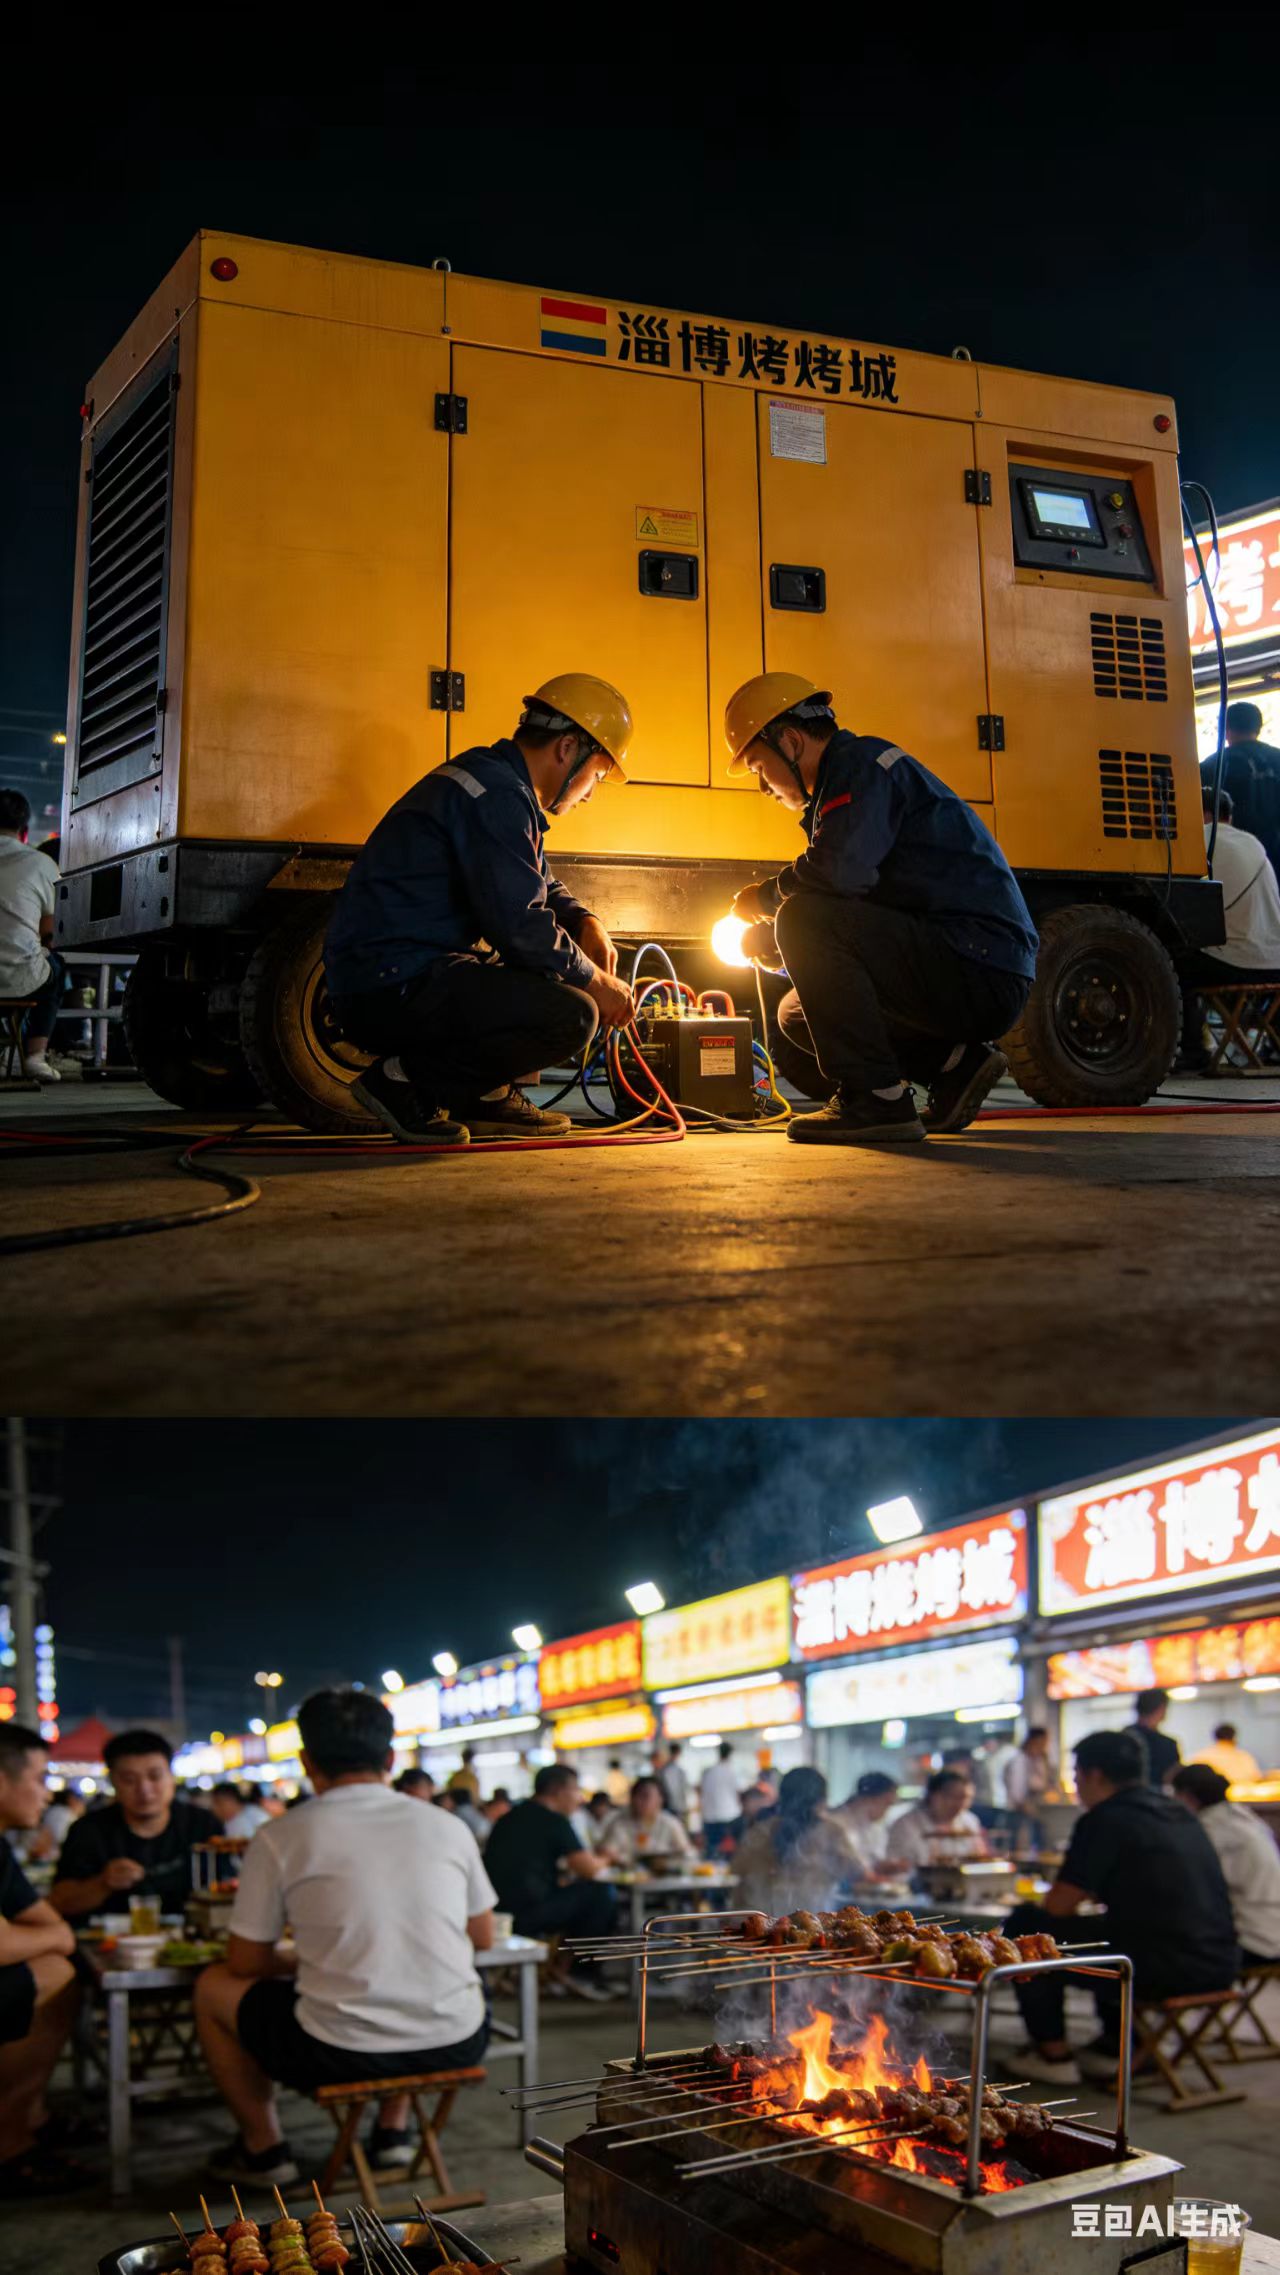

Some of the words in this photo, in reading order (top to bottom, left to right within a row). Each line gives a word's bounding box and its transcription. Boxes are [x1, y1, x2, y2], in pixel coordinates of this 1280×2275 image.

[617, 310, 900, 404] 淄博烤烤城
